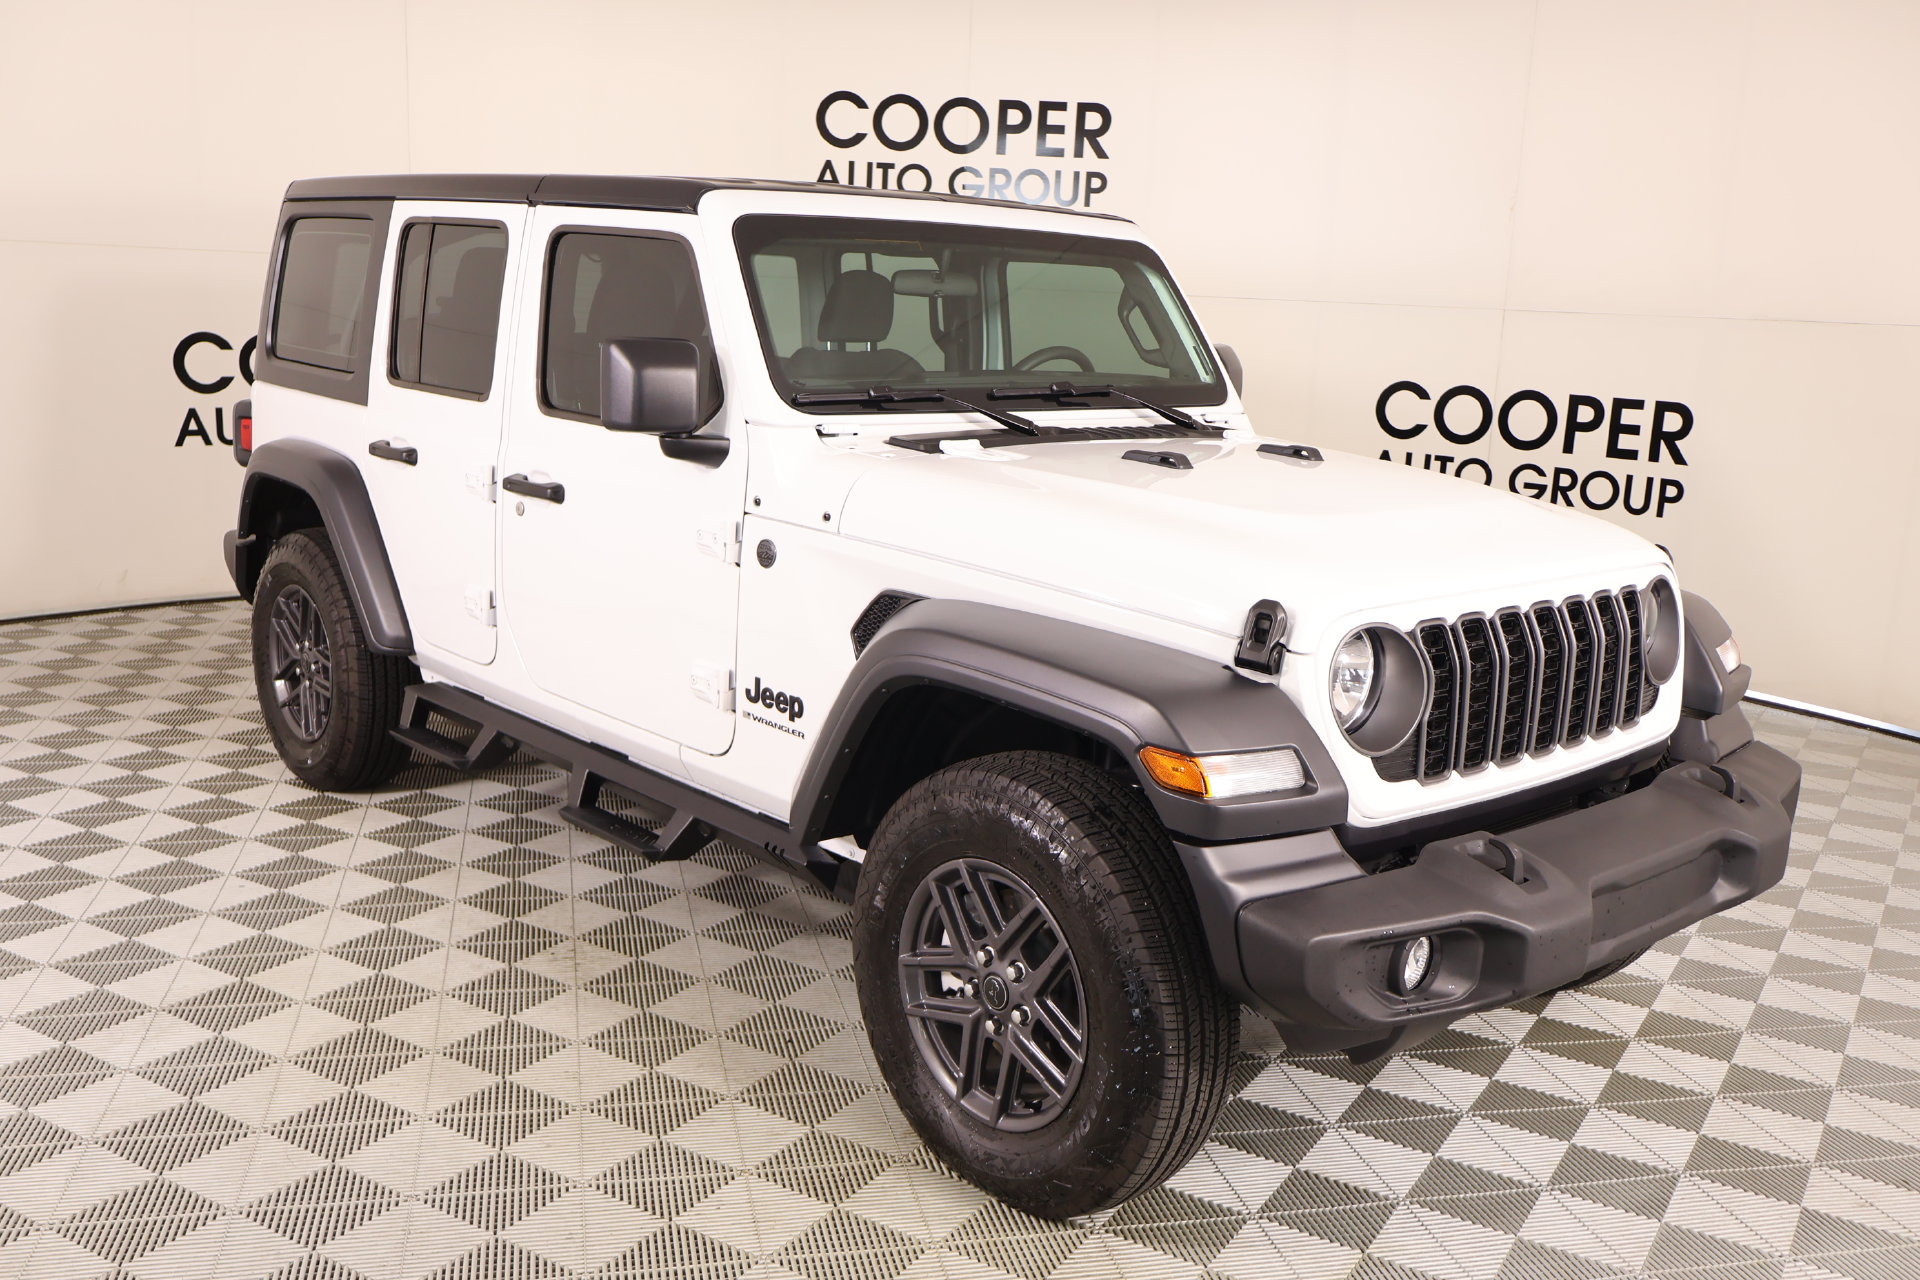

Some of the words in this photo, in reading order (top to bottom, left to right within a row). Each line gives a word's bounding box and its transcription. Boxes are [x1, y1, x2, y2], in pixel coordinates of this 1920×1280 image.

[816, 90, 1112, 159] COOPER
[816, 159, 932, 192] AUTO
[948, 166, 1108, 207] GROUP
[1375, 380, 1694, 466] COOPER
[1508, 463, 1685, 518] GROUP
[745, 676, 804, 722] Jeep
[751, 713, 805, 740] WRANGLER
